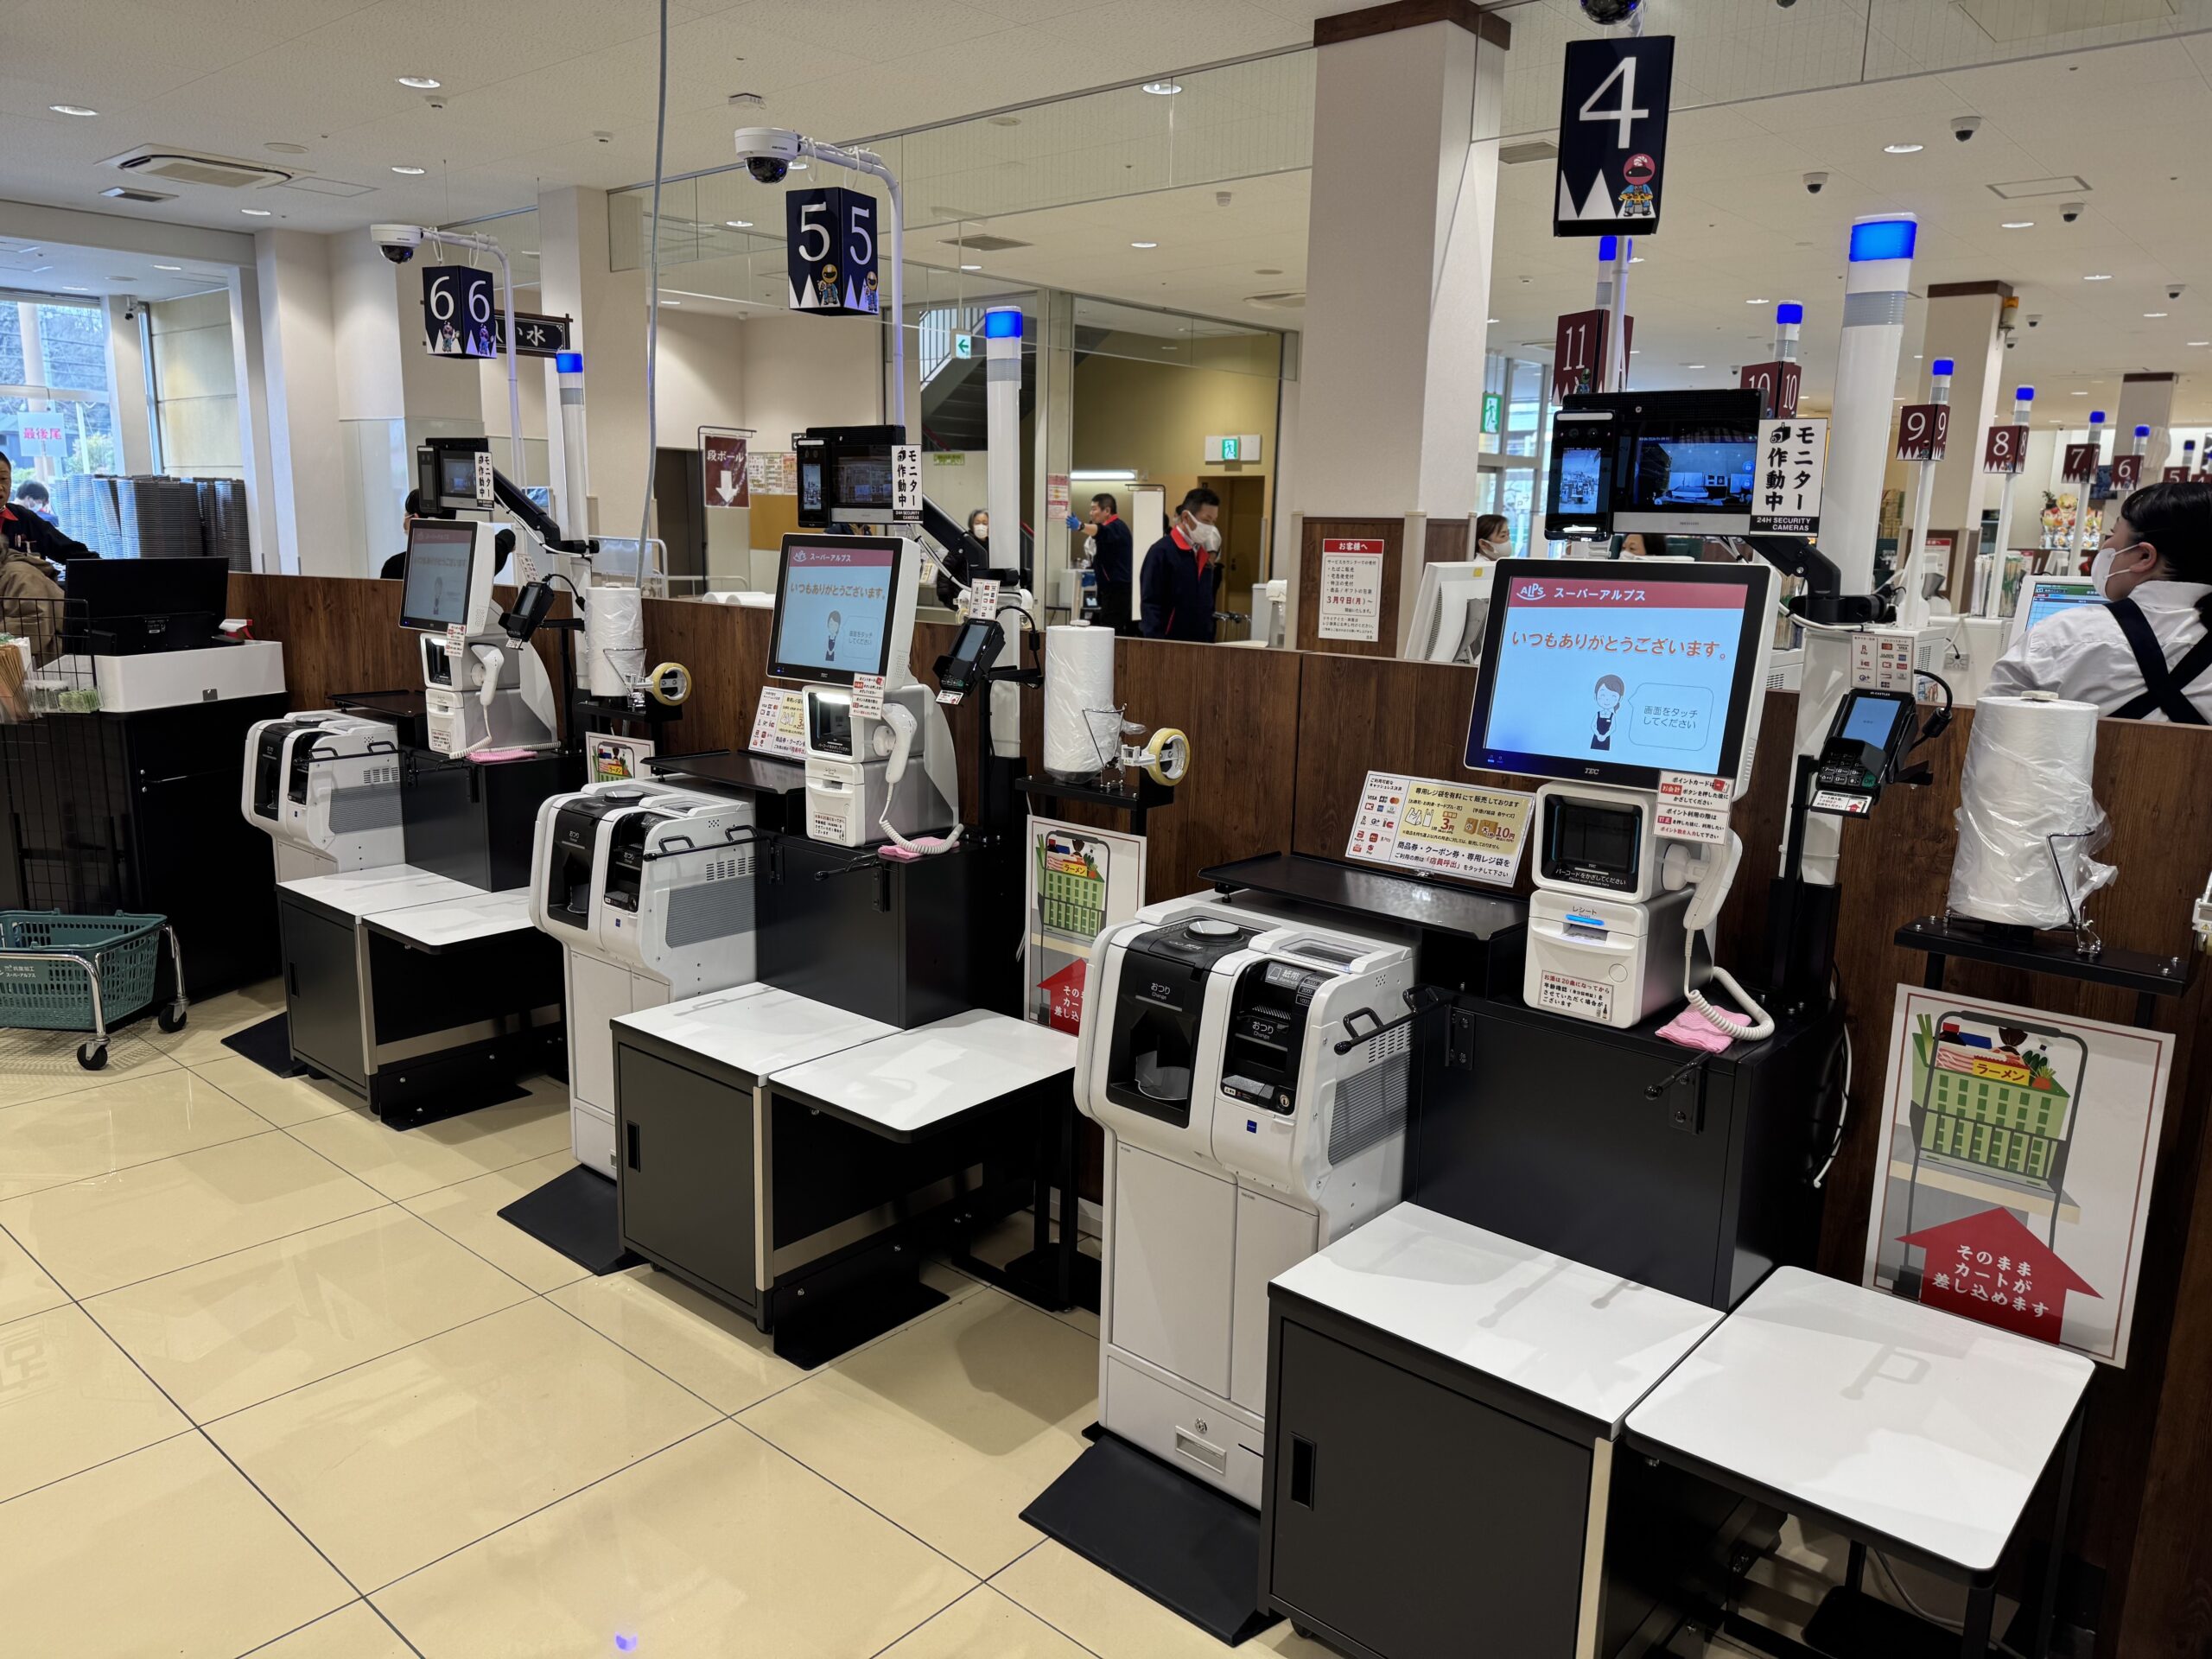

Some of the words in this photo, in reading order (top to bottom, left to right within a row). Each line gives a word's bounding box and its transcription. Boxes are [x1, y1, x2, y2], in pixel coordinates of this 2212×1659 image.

[1579, 56, 1649, 149] 4
[798, 201, 830, 262] 5
[849, 207, 872, 265] 5
[429, 276, 454, 321] 6
[468, 280, 491, 323] 6
[1562, 324, 1587, 372] 11
[1783, 373, 1798, 410] 10
[1907, 412, 1926, 442] 9
[1938, 412, 1947, 433] 9
[23, 427, 62, 440] 最後尾
[2019, 431, 2027, 455] 8
[1993, 431, 2010, 456] 8
[707, 448, 743, 462] 段ボール
[2070, 448, 2085, 469] 7
[908, 449, 918, 506] モニター
[1793, 425, 1815, 511] モニター
[2118, 459, 2132, 478] 6
[897, 464, 906, 508] 作動中
[1764, 447, 1789, 512] 作動中
[1338, 542, 1368, 551] お客様へ
[810, 553, 851, 563] スーパーアルプス
[790, 582, 886, 601] いつもありがとうございます。
[1517, 583, 1546, 600] ALPS
[1554, 587, 1646, 601] スーパーアルプス
[1511, 630, 1726, 660] いつもありがとうございます。
[1643, 704, 1698, 718] 画面をタッチ
[1643, 717, 1697, 730] してください
[1672, 777, 1715, 788] ポイントカードは
[1662, 785, 1681, 793] お会計
[1682, 788, 1729, 800] ボタンを押した後に
[1673, 796, 1713, 805] かざしてください
[1666, 808, 1717, 820] ポイント利用の際は
[1440, 817, 1455, 831] 3円
[1496, 826, 1516, 840] 10円
[1396, 841, 1510, 868] 商品券・クーポン券・専用レジ袋を
[1063, 863, 1086, 875] ラーメン
[1555, 868, 1626, 886] バーコードをかざしてください
[1573, 905, 1597, 915] レシート
[1281, 969, 1300, 981] 紙幣
[1544, 974, 1610, 994] お酒は20歳になってから
[1150, 982, 1171, 995] おつり
[1543, 989, 1604, 1007] させていただく場合が
[1542, 996, 1572, 1007] ございます
[1252, 1020, 1274, 1034] おつり
[1976, 1062, 2025, 1083] ラーメン
[1956, 1244, 2031, 1276] そのまま
[1955, 1262, 2032, 1294] カートが
[1932, 1271, 2050, 1319] 差し込めます
